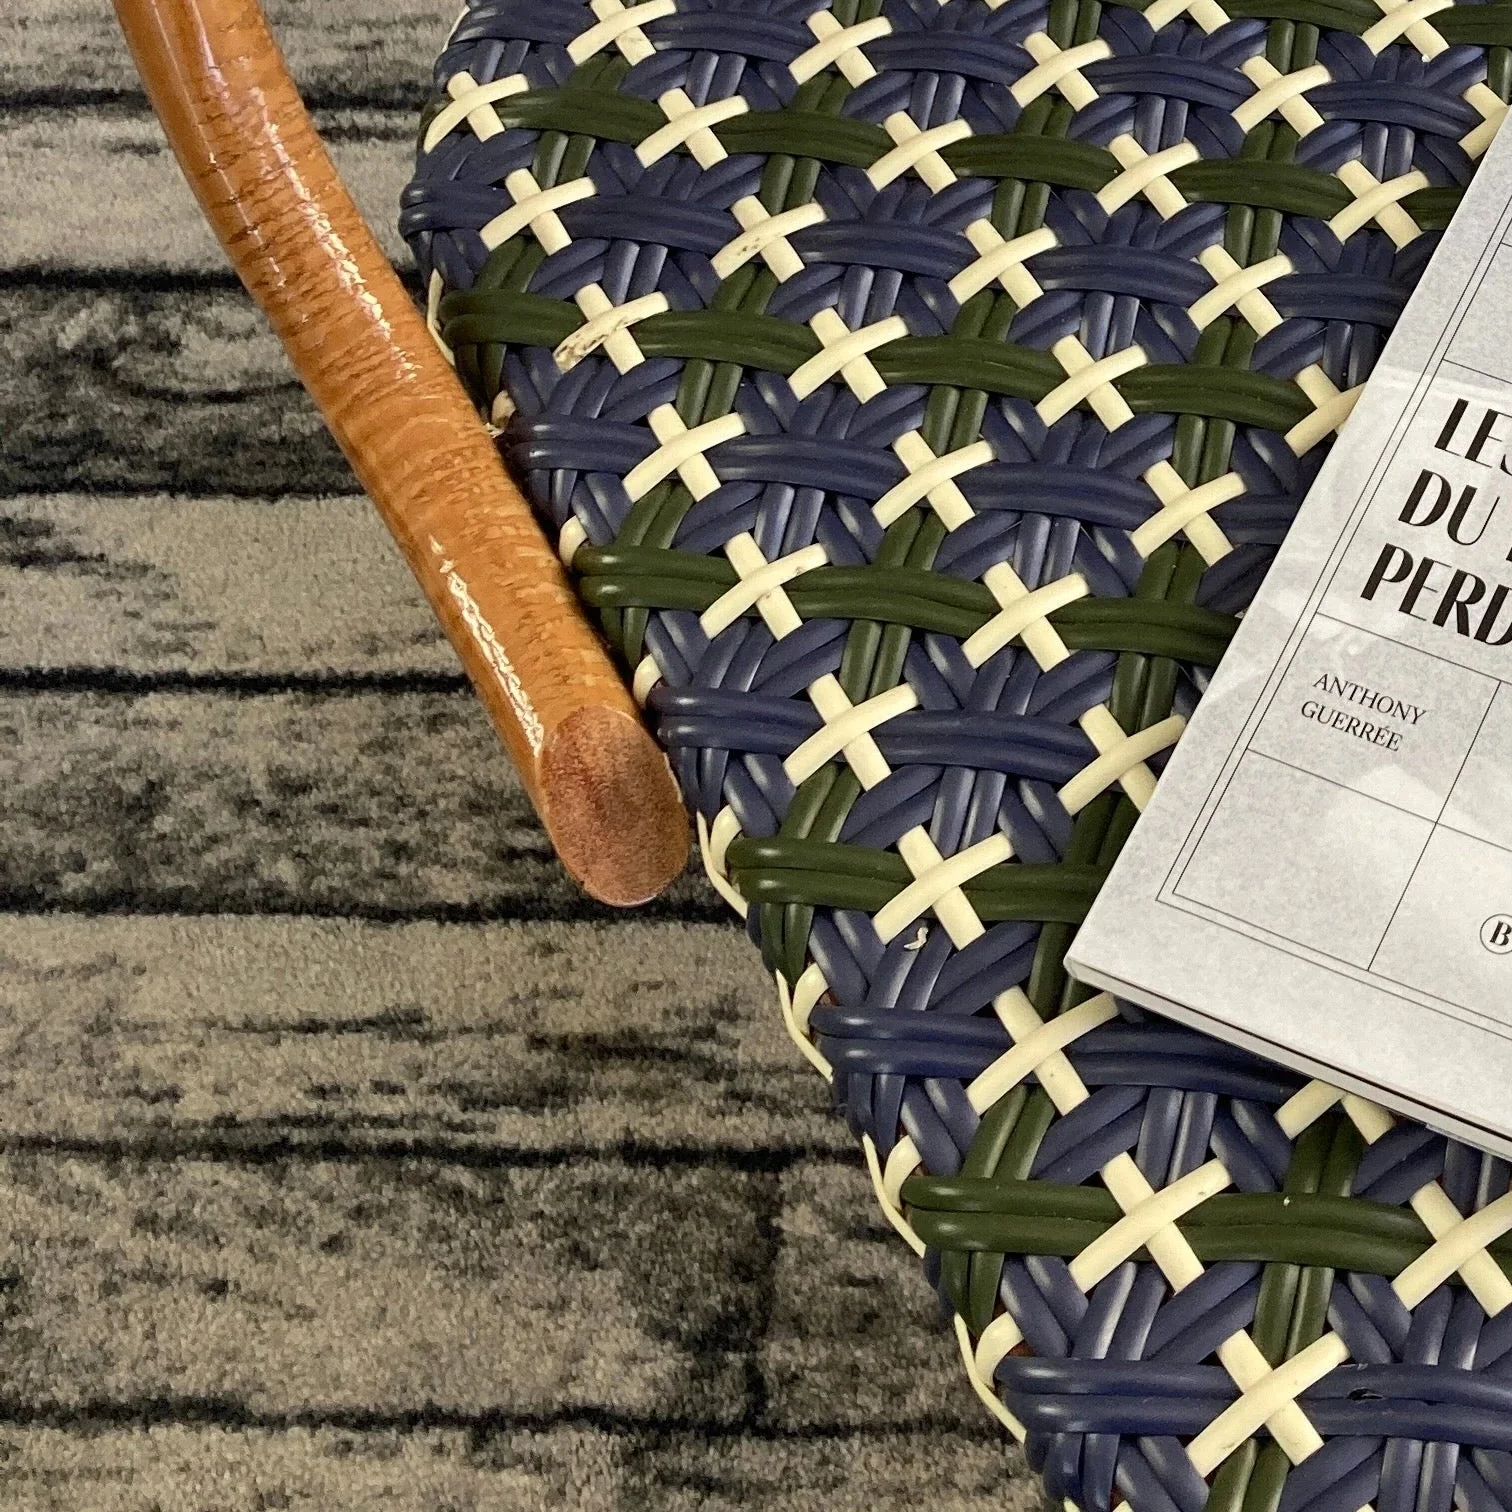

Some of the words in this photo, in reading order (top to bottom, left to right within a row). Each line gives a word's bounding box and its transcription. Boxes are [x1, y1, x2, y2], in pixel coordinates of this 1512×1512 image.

[1397, 468, 1501, 546] DU
[1300, 700, 1404, 752] GUERRÉE
[1312, 673, 1427, 726] ANTHONY
